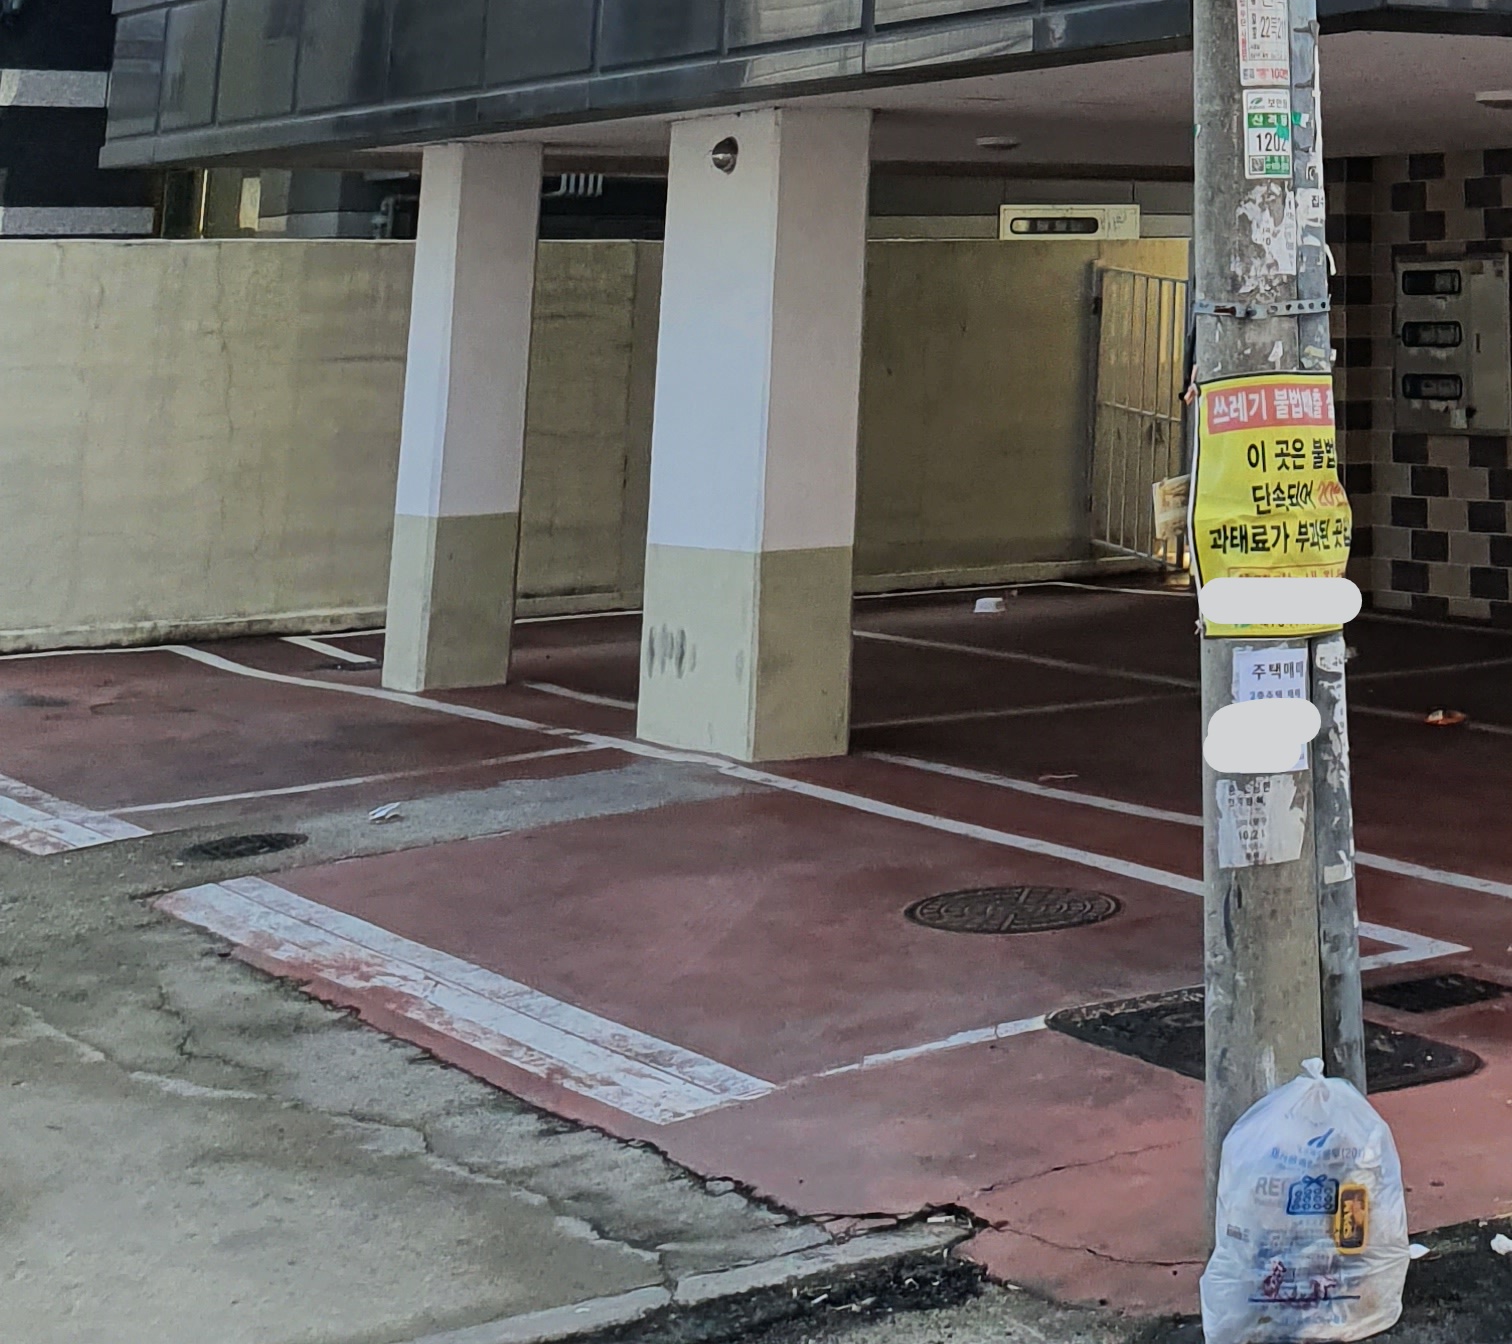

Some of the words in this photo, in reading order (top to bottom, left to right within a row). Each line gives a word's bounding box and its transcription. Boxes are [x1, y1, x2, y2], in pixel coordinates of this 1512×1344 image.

[1213, 389, 1267, 425] 쓰레기
[1247, 440, 1267, 473] 이
[1274, 438, 1306, 471] 곳은
[1209, 521, 1290, 555] 과태료가
